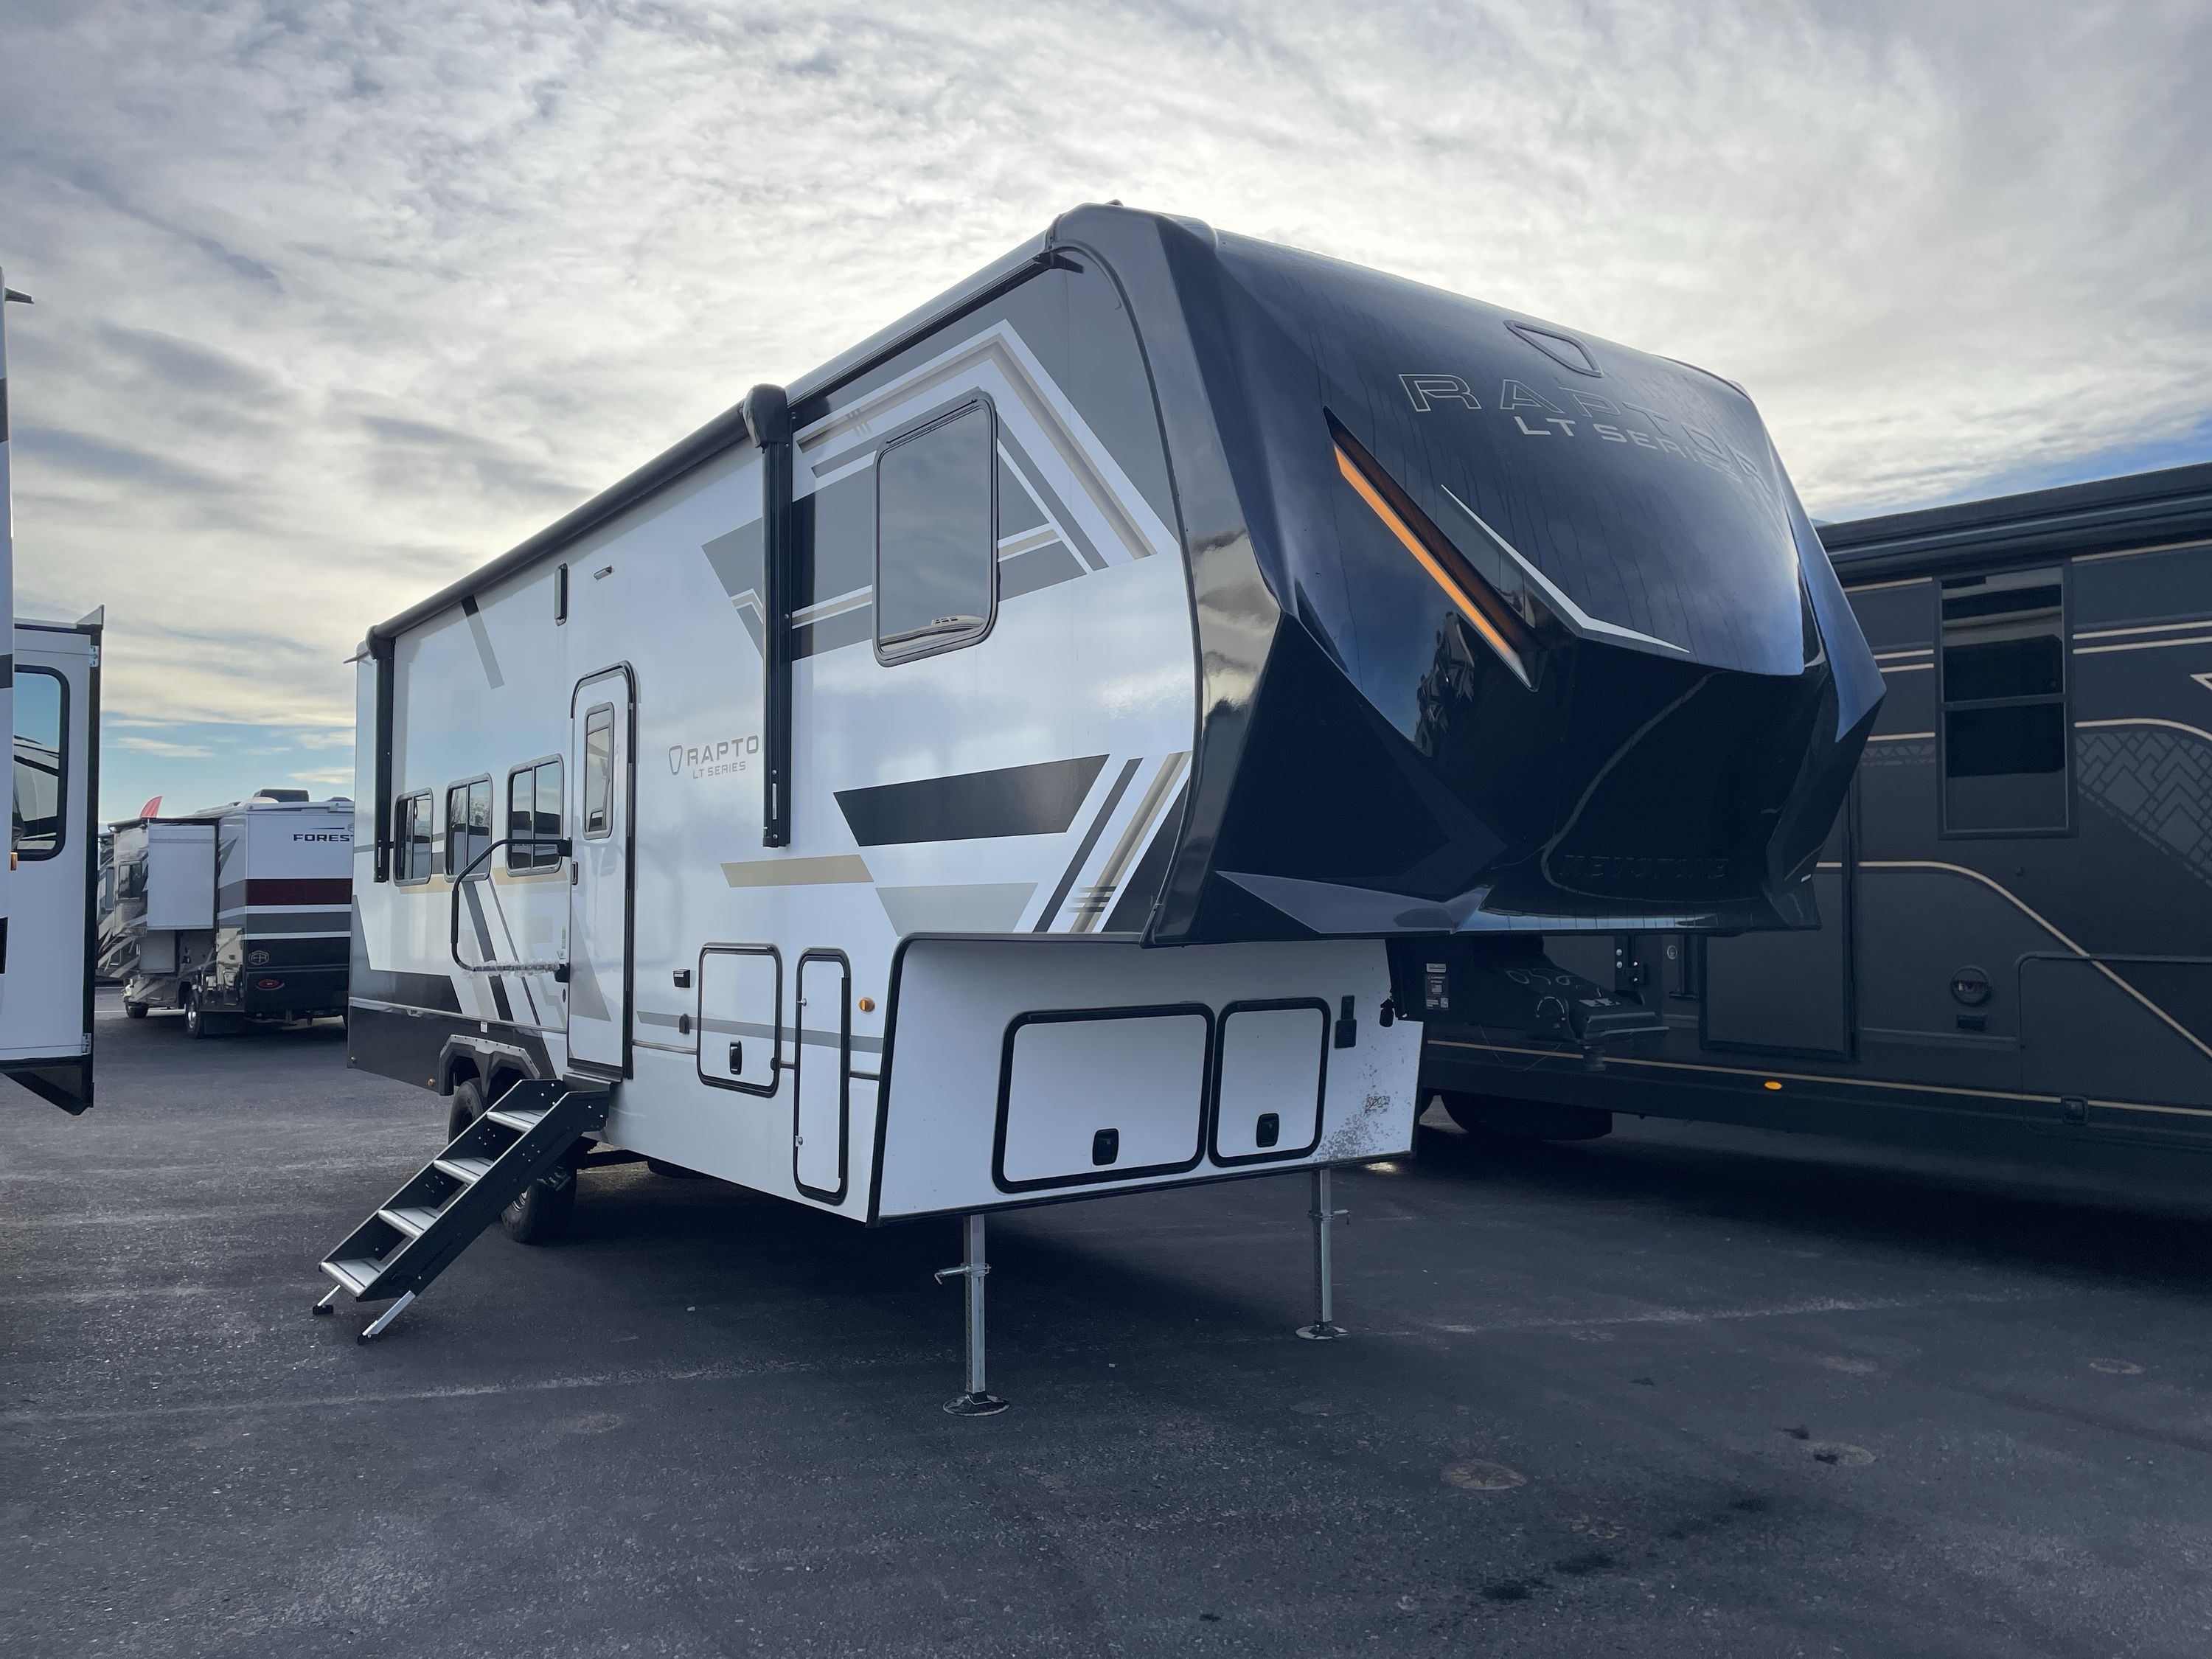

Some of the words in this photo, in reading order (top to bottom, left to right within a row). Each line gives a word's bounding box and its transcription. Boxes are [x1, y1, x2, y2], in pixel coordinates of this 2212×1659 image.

[1398, 373, 1771, 494] RAPTOR
[1514, 415, 1576, 437] LT
[1593, 423, 1743, 484] SERIES
[686, 734, 765, 766] RAPTO
[692, 768, 705, 779] LT
[707, 760, 746, 776] SERIES
